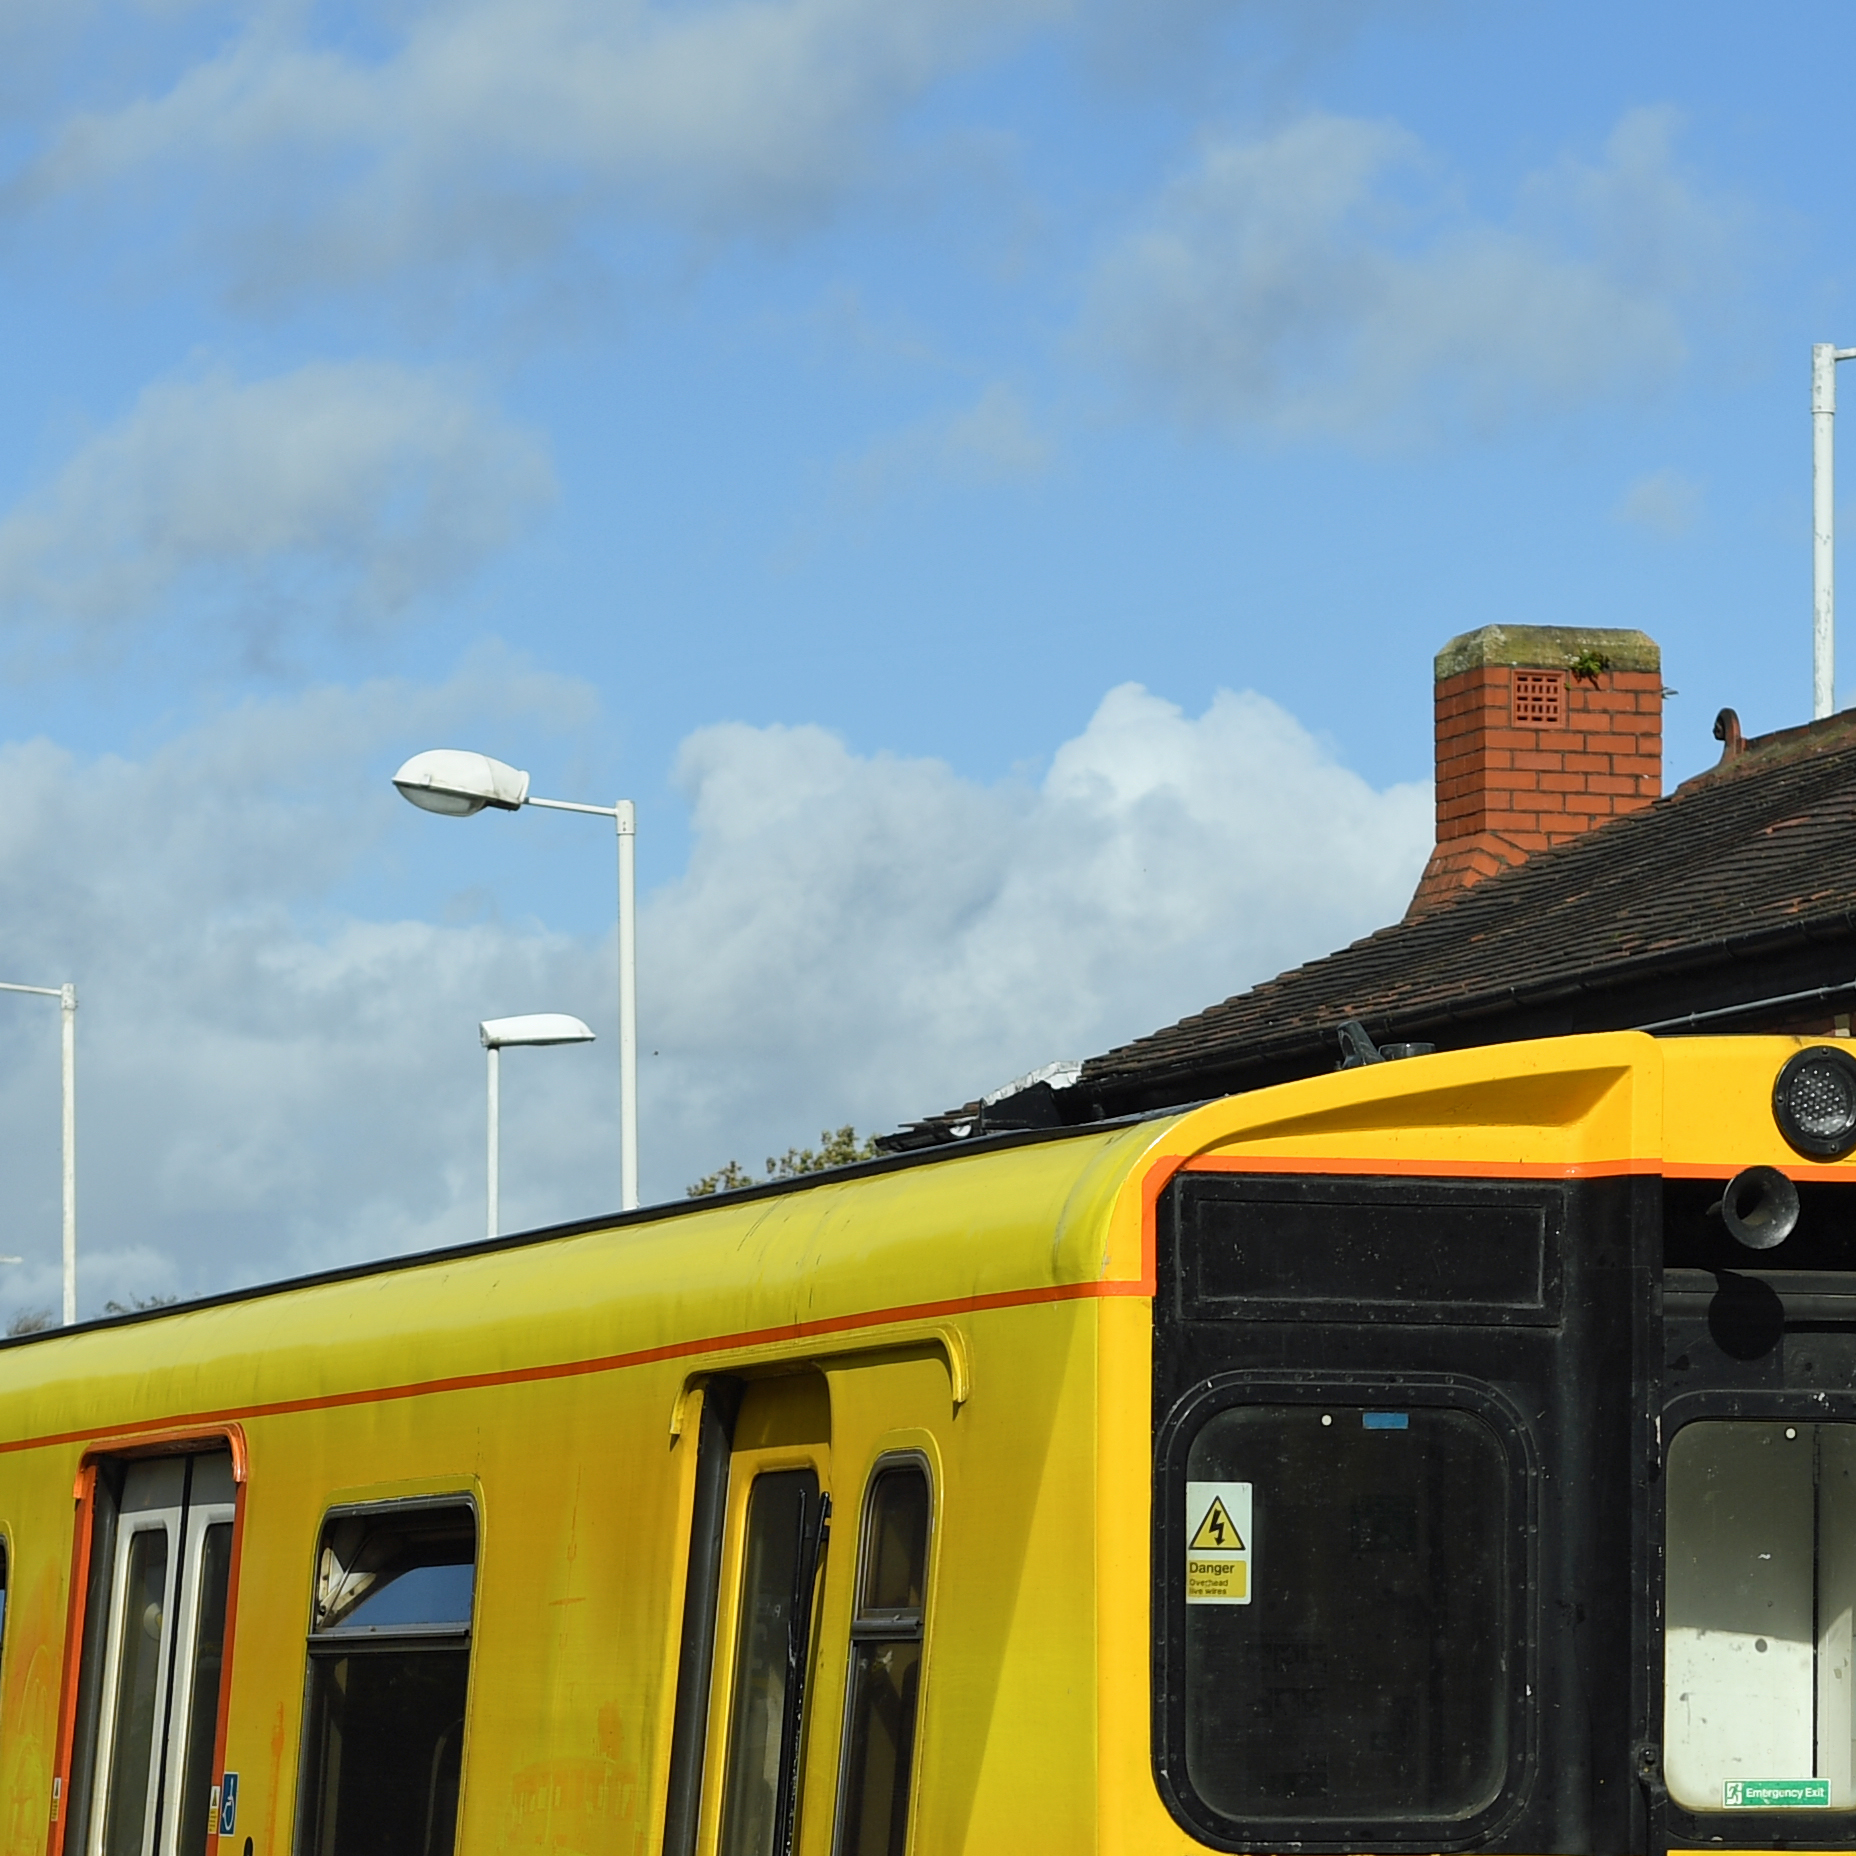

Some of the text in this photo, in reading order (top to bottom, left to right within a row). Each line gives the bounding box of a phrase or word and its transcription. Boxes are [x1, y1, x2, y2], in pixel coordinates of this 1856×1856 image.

[1189, 1562, 1234, 1576] Danger
[1189, 1578, 1229, 1587] Overhead
[1189, 1587, 1227, 1595] live wires
[1746, 1787, 1824, 1800] Emergency Exit
